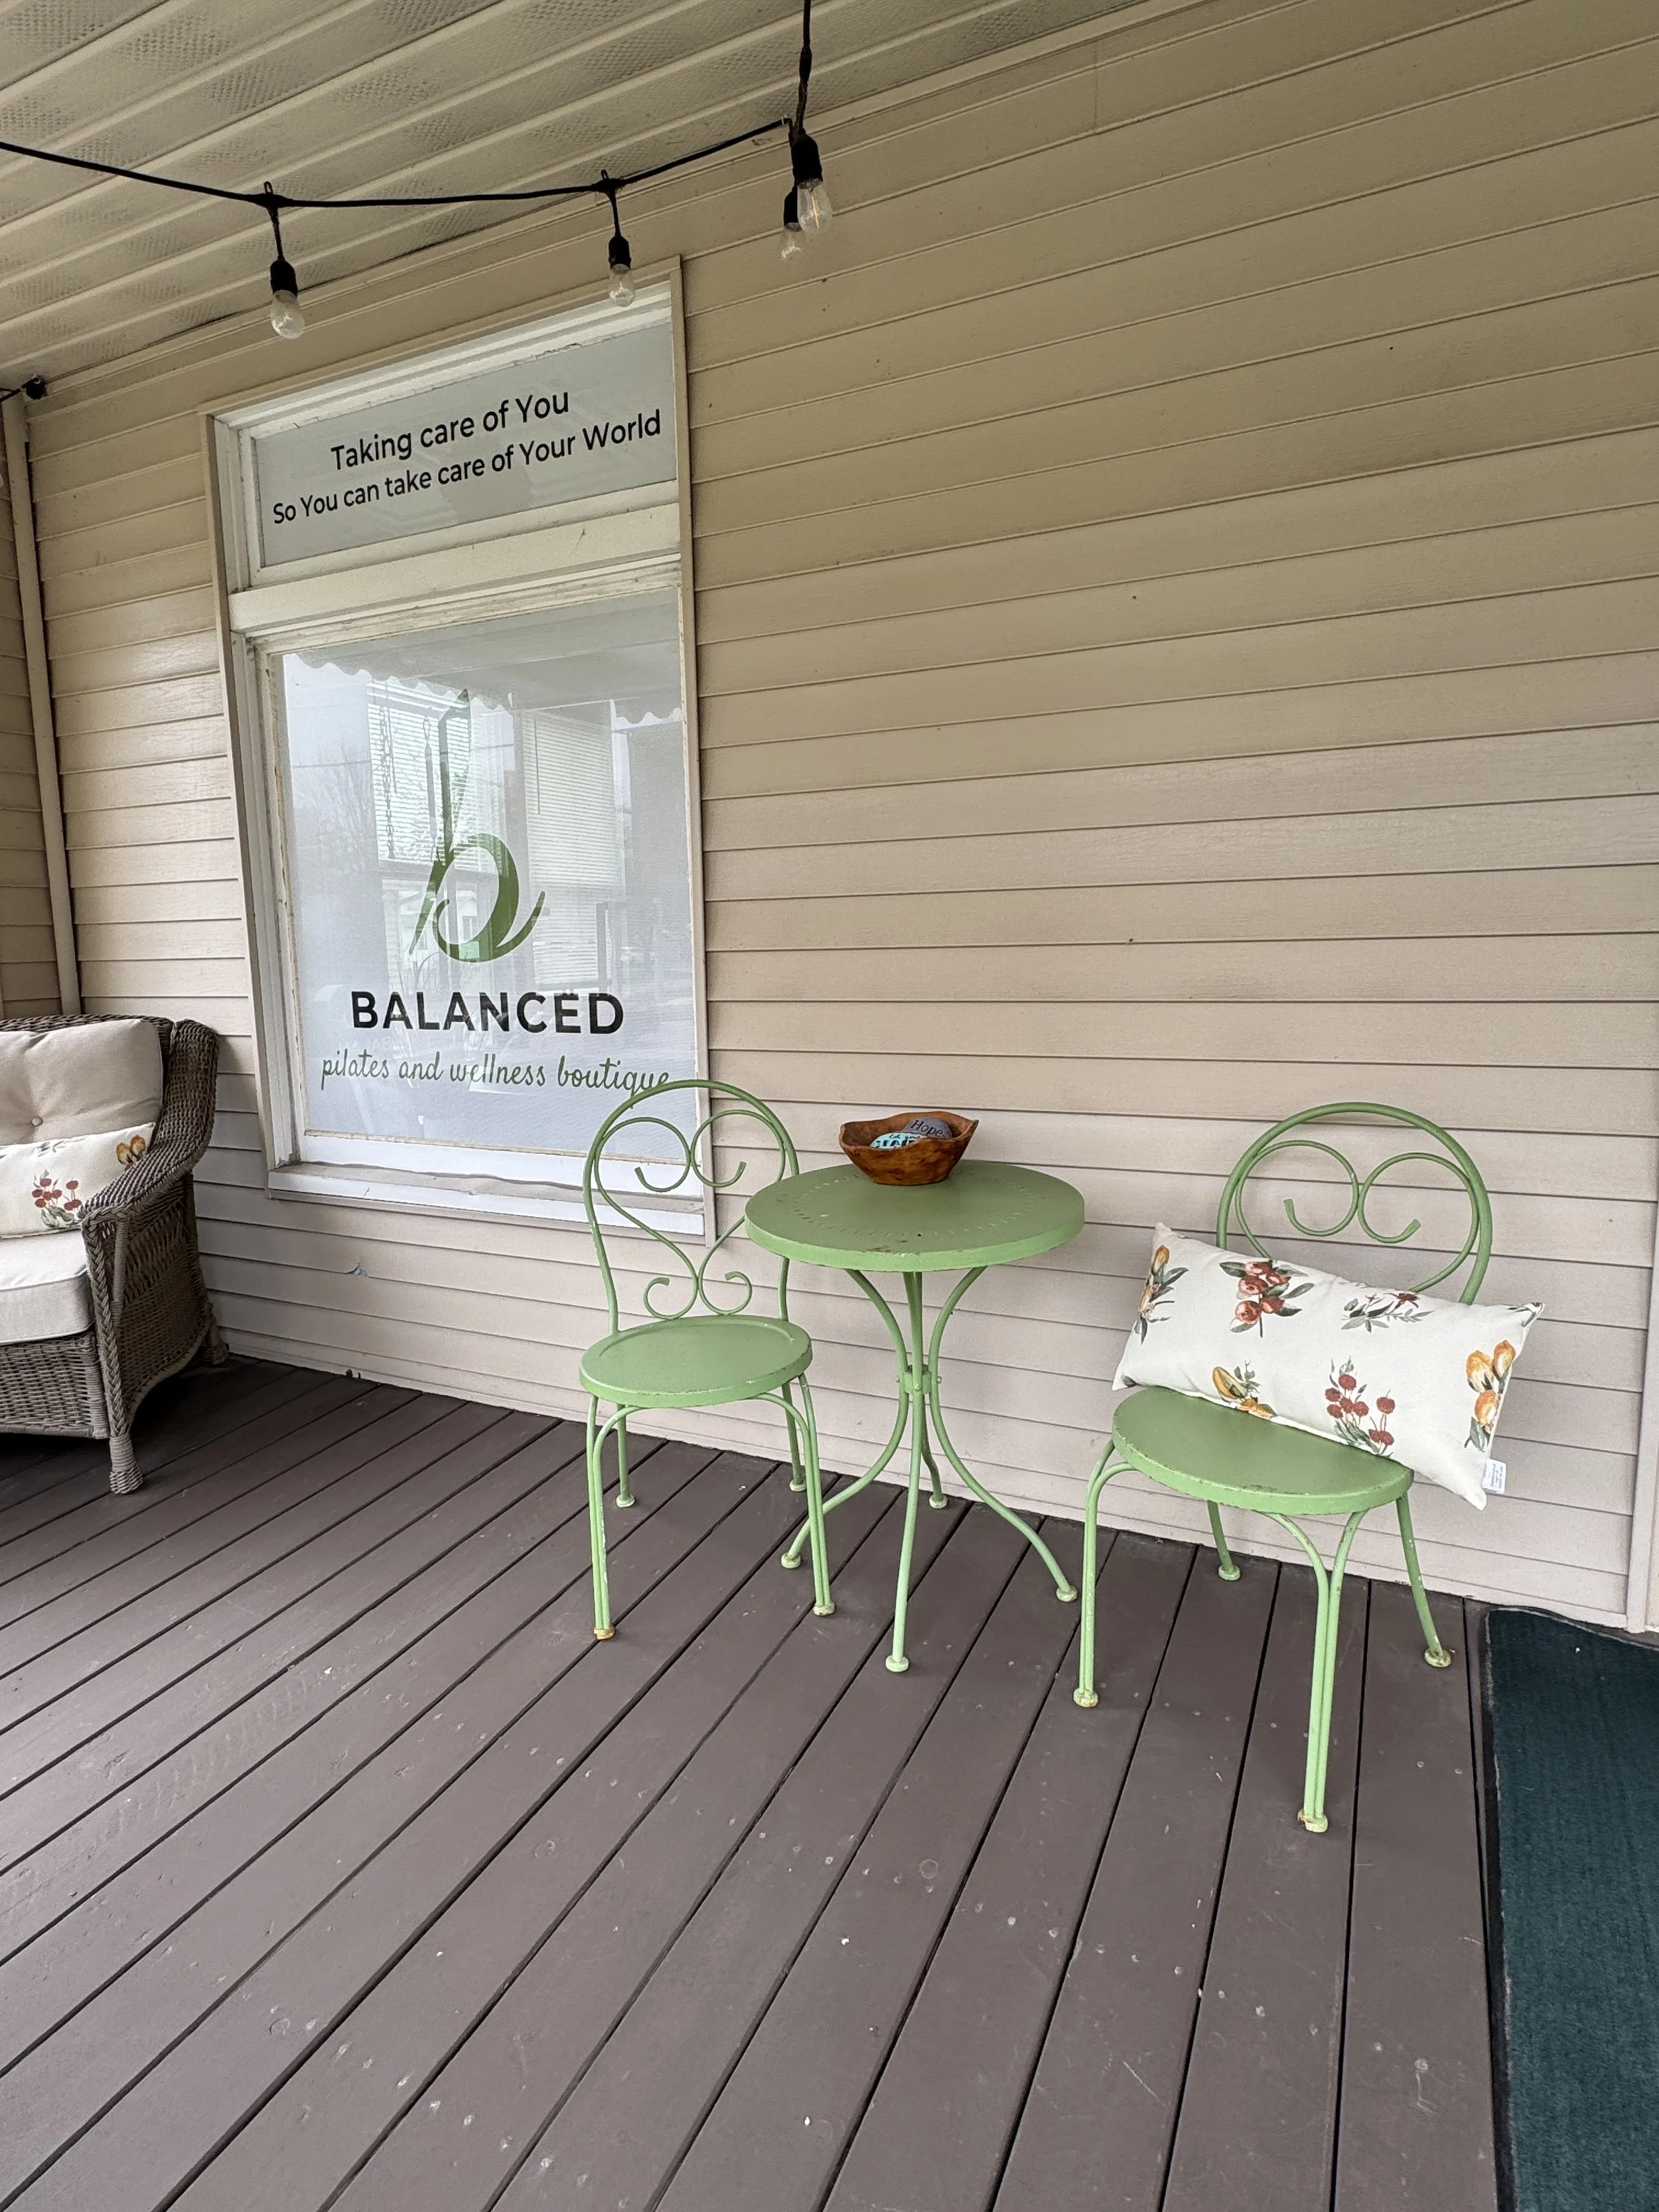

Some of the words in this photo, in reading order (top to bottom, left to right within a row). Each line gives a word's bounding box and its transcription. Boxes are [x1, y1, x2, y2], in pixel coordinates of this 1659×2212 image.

[330, 432, 412, 471] Taking
[420, 417, 474, 448] care
[482, 399, 510, 433] of
[514, 392, 569, 423] You
[273, 502, 297, 524] So
[299, 494, 338, 517] You
[343, 484, 380, 507] can
[384, 469, 432, 498] take
[437, 454, 485, 485] care
[491, 443, 515, 473] of
[519, 435, 576, 465] Your
[582, 408, 661, 451] World
[351, 991, 624, 1035] BALANCED
[321, 1048, 390, 1090] pilates
[398, 1051, 444, 1080] and
[449, 1053, 546, 1086] wellness
[557, 1055, 669, 1110] boutique
[910, 1119, 944, 1136] Hope
